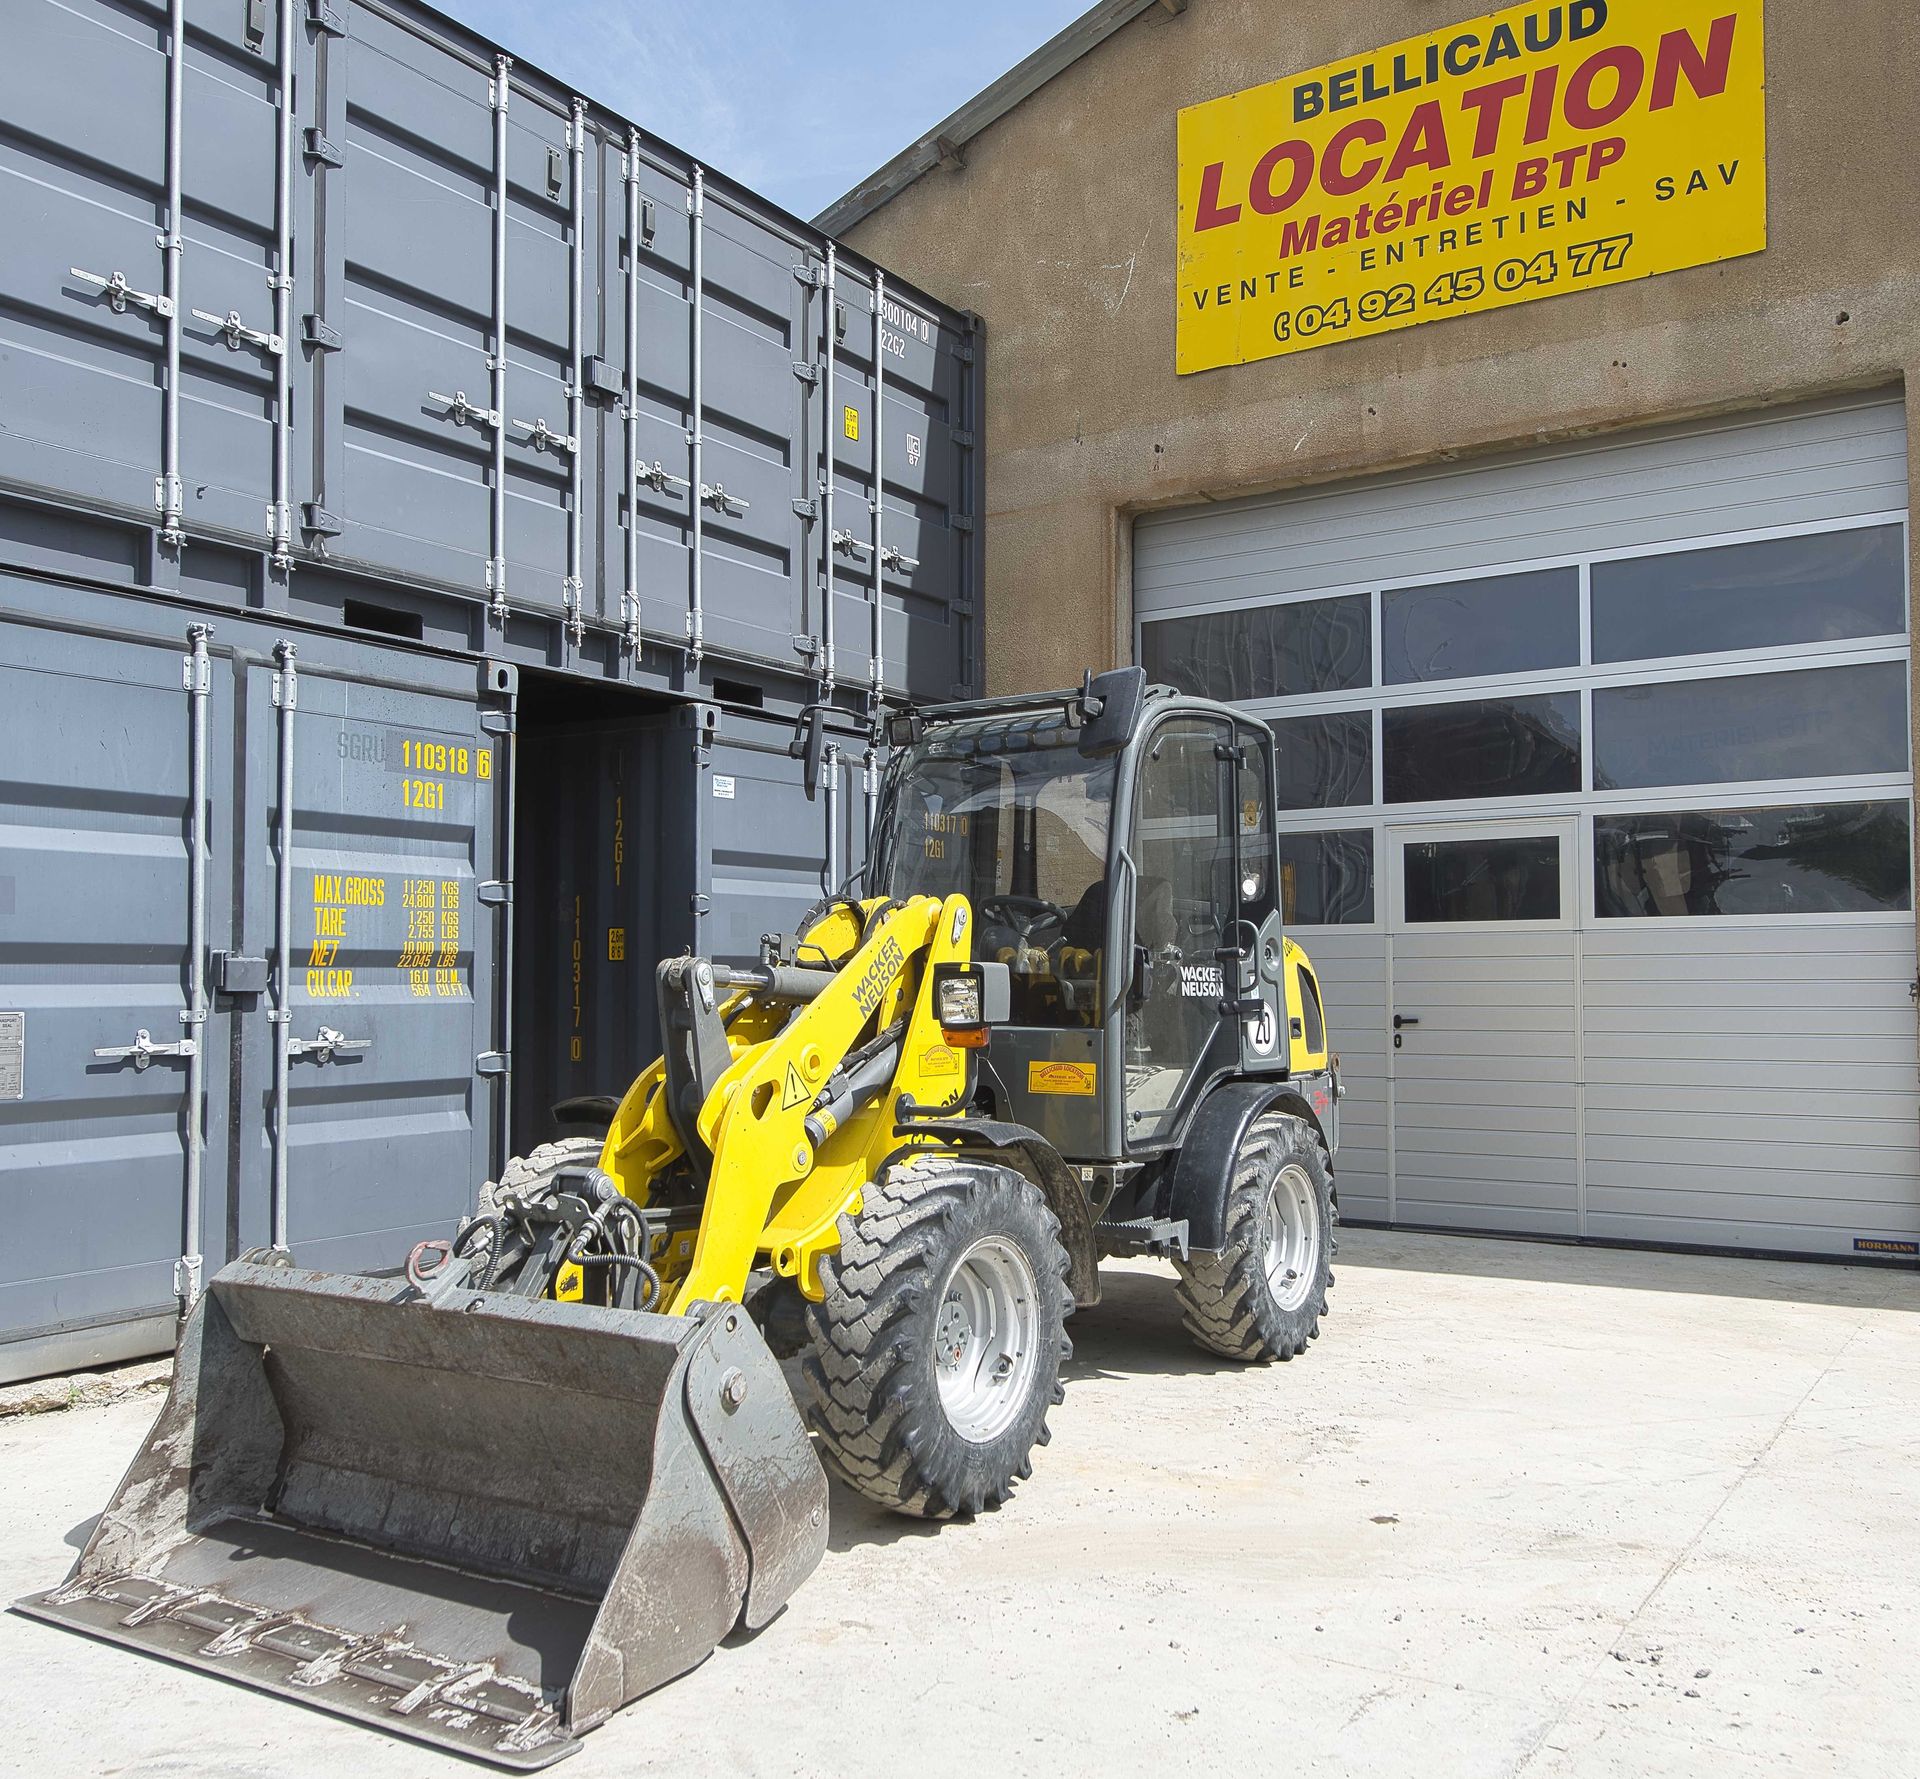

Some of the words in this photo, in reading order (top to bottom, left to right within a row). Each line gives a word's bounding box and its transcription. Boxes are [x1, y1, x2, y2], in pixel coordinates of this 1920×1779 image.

[1292, 0, 1609, 124] BELLICAUD
[1194, 13, 1738, 233] LOCATION
[1278, 170, 1492, 260] Matériel
[1510, 137, 1627, 202] BTP
[1193, 266, 1304, 311] VENTE
[1360, 196, 1588, 272] ENTRETIEN
[1655, 160, 1741, 202] SAV
[1295, 295, 1352, 337] 04
[1358, 283, 1417, 322] 92
[1423, 267, 1485, 306] 45
[1493, 252, 1559, 291] 04
[1567, 233, 1633, 275] 77
[881, 328, 905, 359] 22G2
[909, 454, 919, 467] 87
[402, 740, 468, 775] 110318
[478, 750, 490, 778] 6
[402, 779, 444, 810] 12G1
[923, 811, 957, 834] 110317
[614, 796, 623, 887] 12G1
[923, 838, 945, 859] 12G1
[313, 874, 384, 906] MAX.GROSS
[403, 879, 435, 895] 11,250
[441, 881, 459, 895] KGS
[402, 894, 435, 909] 24,800
[441, 895, 459, 909] LBS
[314, 907, 347, 937] TARE
[409, 910, 435, 925] 1,250
[441, 911, 459, 925] KGS
[408, 924, 435, 939] 2,755
[441, 925, 459, 939] LBS
[307, 939, 340, 967] NET
[403, 940, 435, 956] 10,000
[440, 941, 459, 955] KGS
[436, 954, 457, 968] LBS
[572, 895, 581, 1028] 110317
[409, 969, 429, 984] 16.0
[435, 969, 461, 984] CU.M.
[852, 935, 898, 1003] WACKER
[859, 947, 905, 1020] NEUSON
[1180, 966, 1223, 982] WACKER
[411, 983, 432, 998] 564
[436, 983, 468, 997] CU.FT.
[1181, 981, 1224, 997] NEUSON
